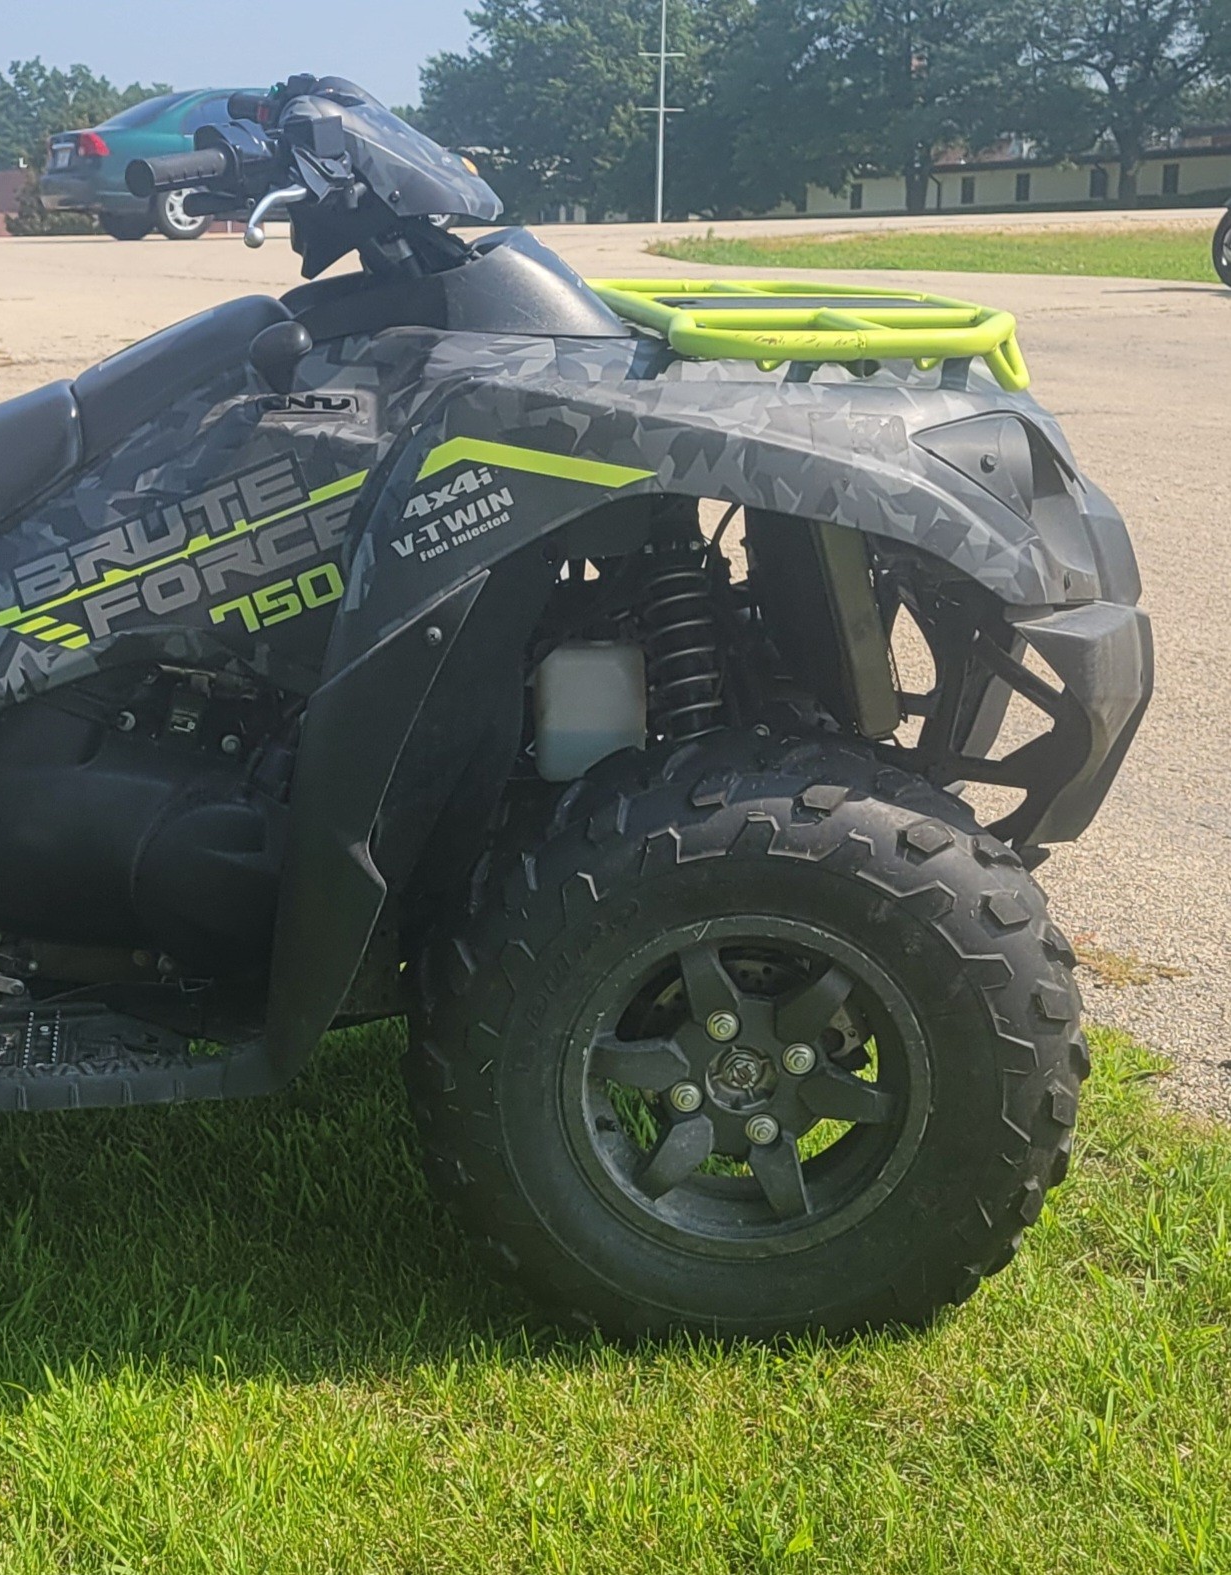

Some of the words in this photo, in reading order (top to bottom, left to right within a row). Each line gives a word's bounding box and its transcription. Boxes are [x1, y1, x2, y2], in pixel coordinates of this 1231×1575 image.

[390, 487, 514, 558] V-TWIN
[403, 466, 493, 519] 4x4i
[14, 458, 303, 606] BRUTE
[83, 494, 362, 639] FORCE
[419, 541, 449, 562] Fuel
[452, 511, 511, 546] Injected
[209, 562, 345, 633] 750
